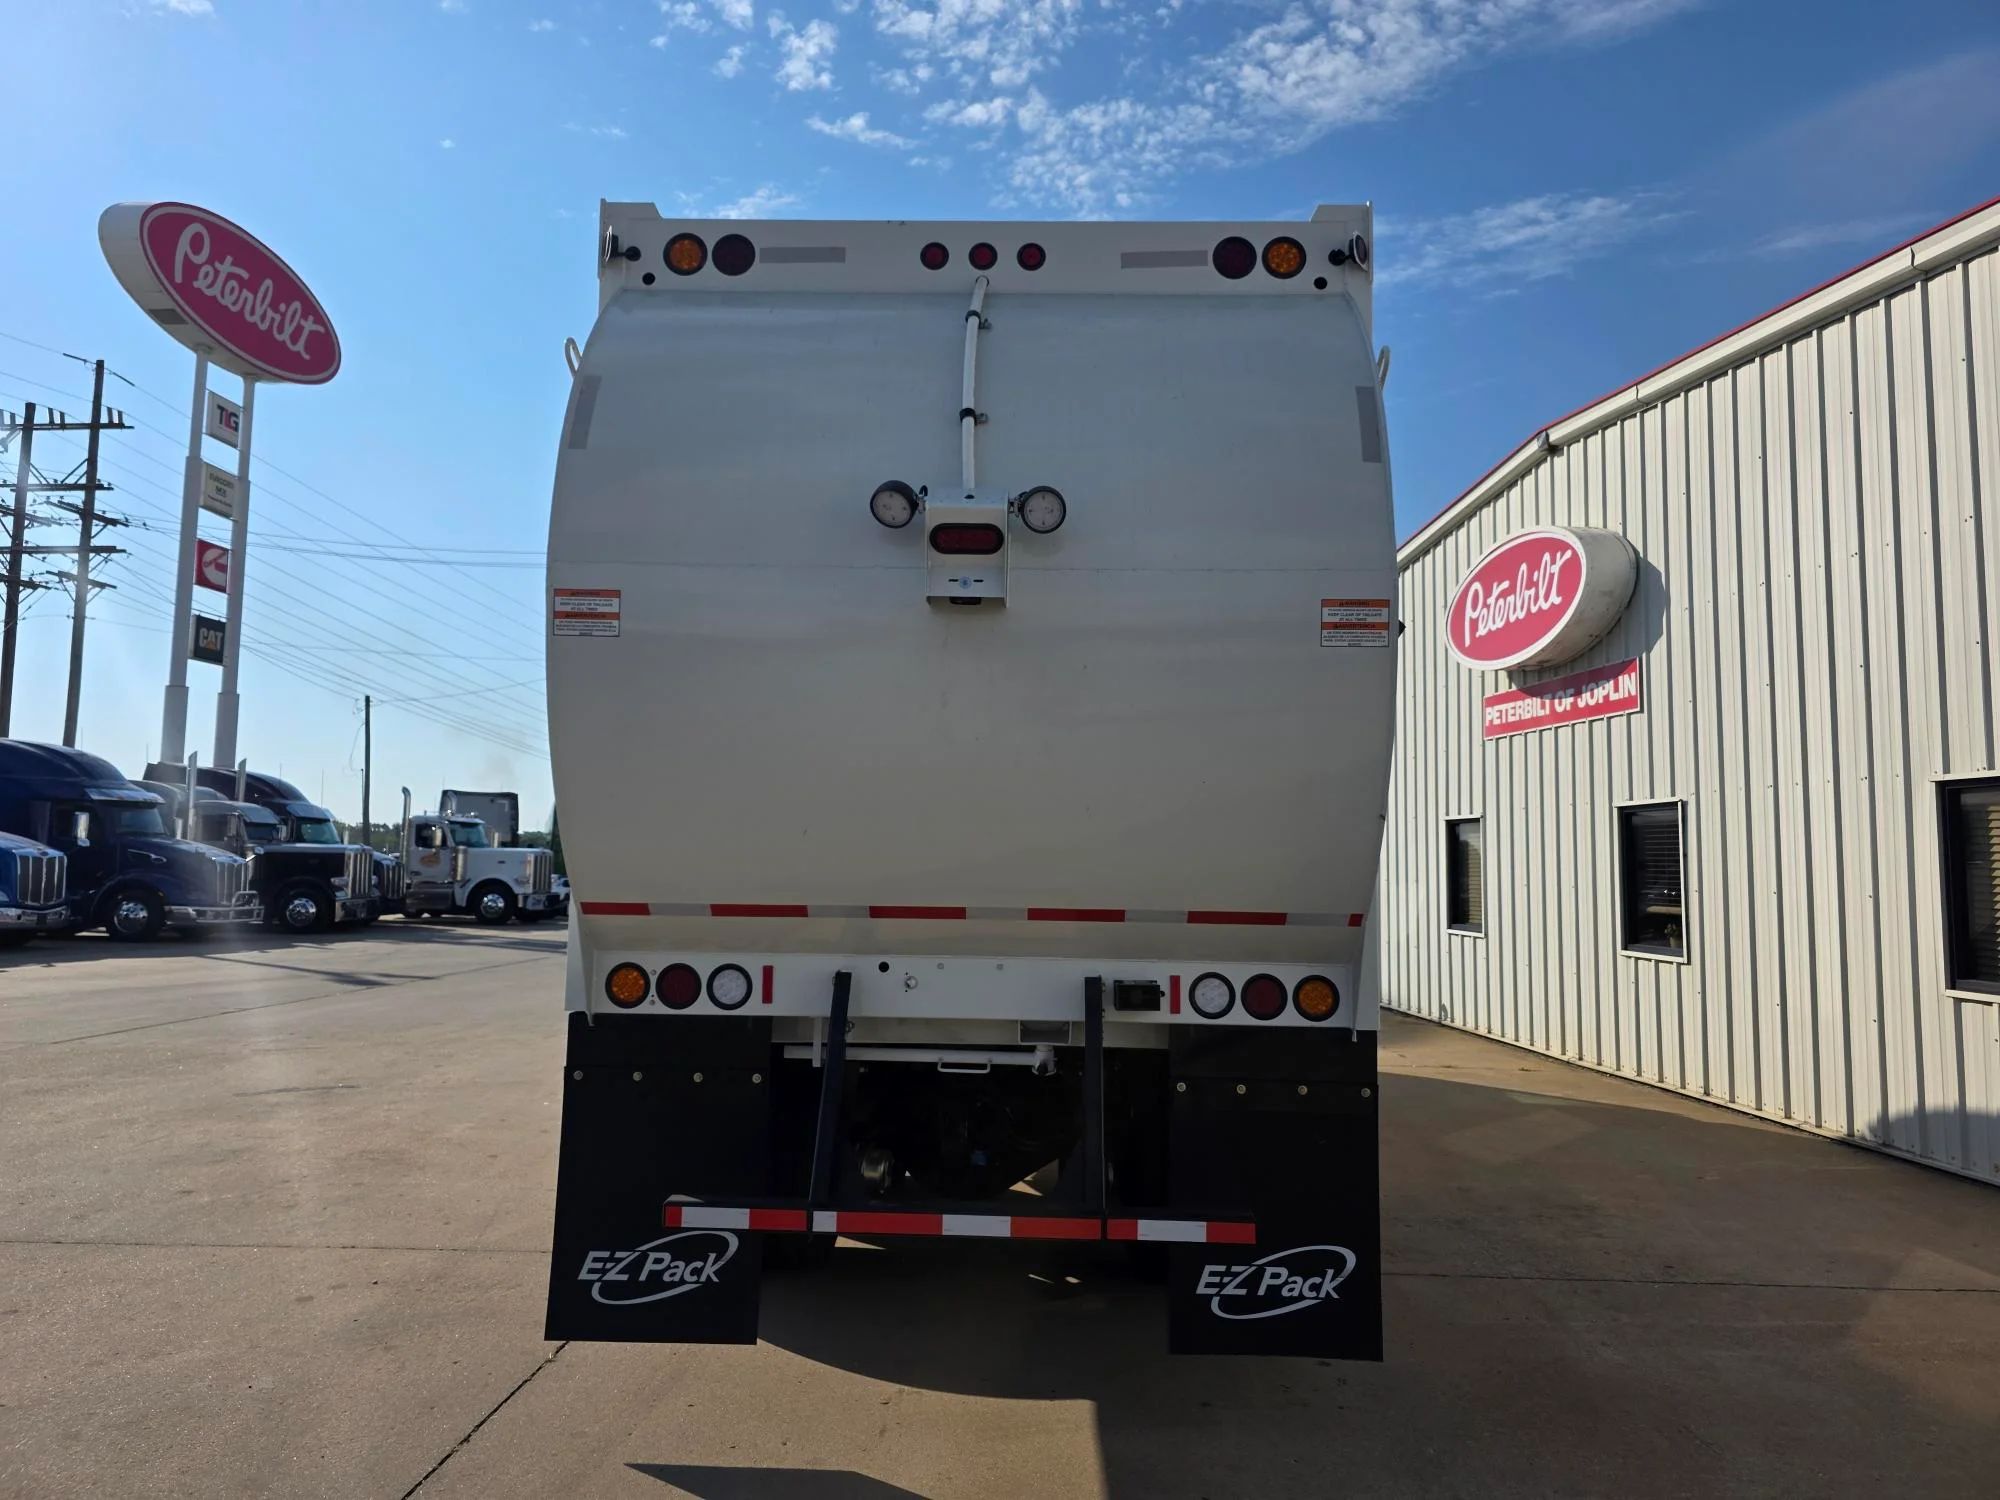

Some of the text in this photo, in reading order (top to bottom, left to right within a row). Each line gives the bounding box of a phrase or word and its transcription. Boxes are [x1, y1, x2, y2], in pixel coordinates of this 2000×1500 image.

[174, 222, 325, 361] Peterbilt
[216, 403, 239, 433] TLG
[1464, 548, 1573, 648] Peterbilt
[199, 627, 224, 651] CAT
[1485, 671, 1638, 728] PETERBILT OF JOPLIN
[638, 1251, 724, 1283] Pack
[1257, 1266, 1344, 1299] Pack
